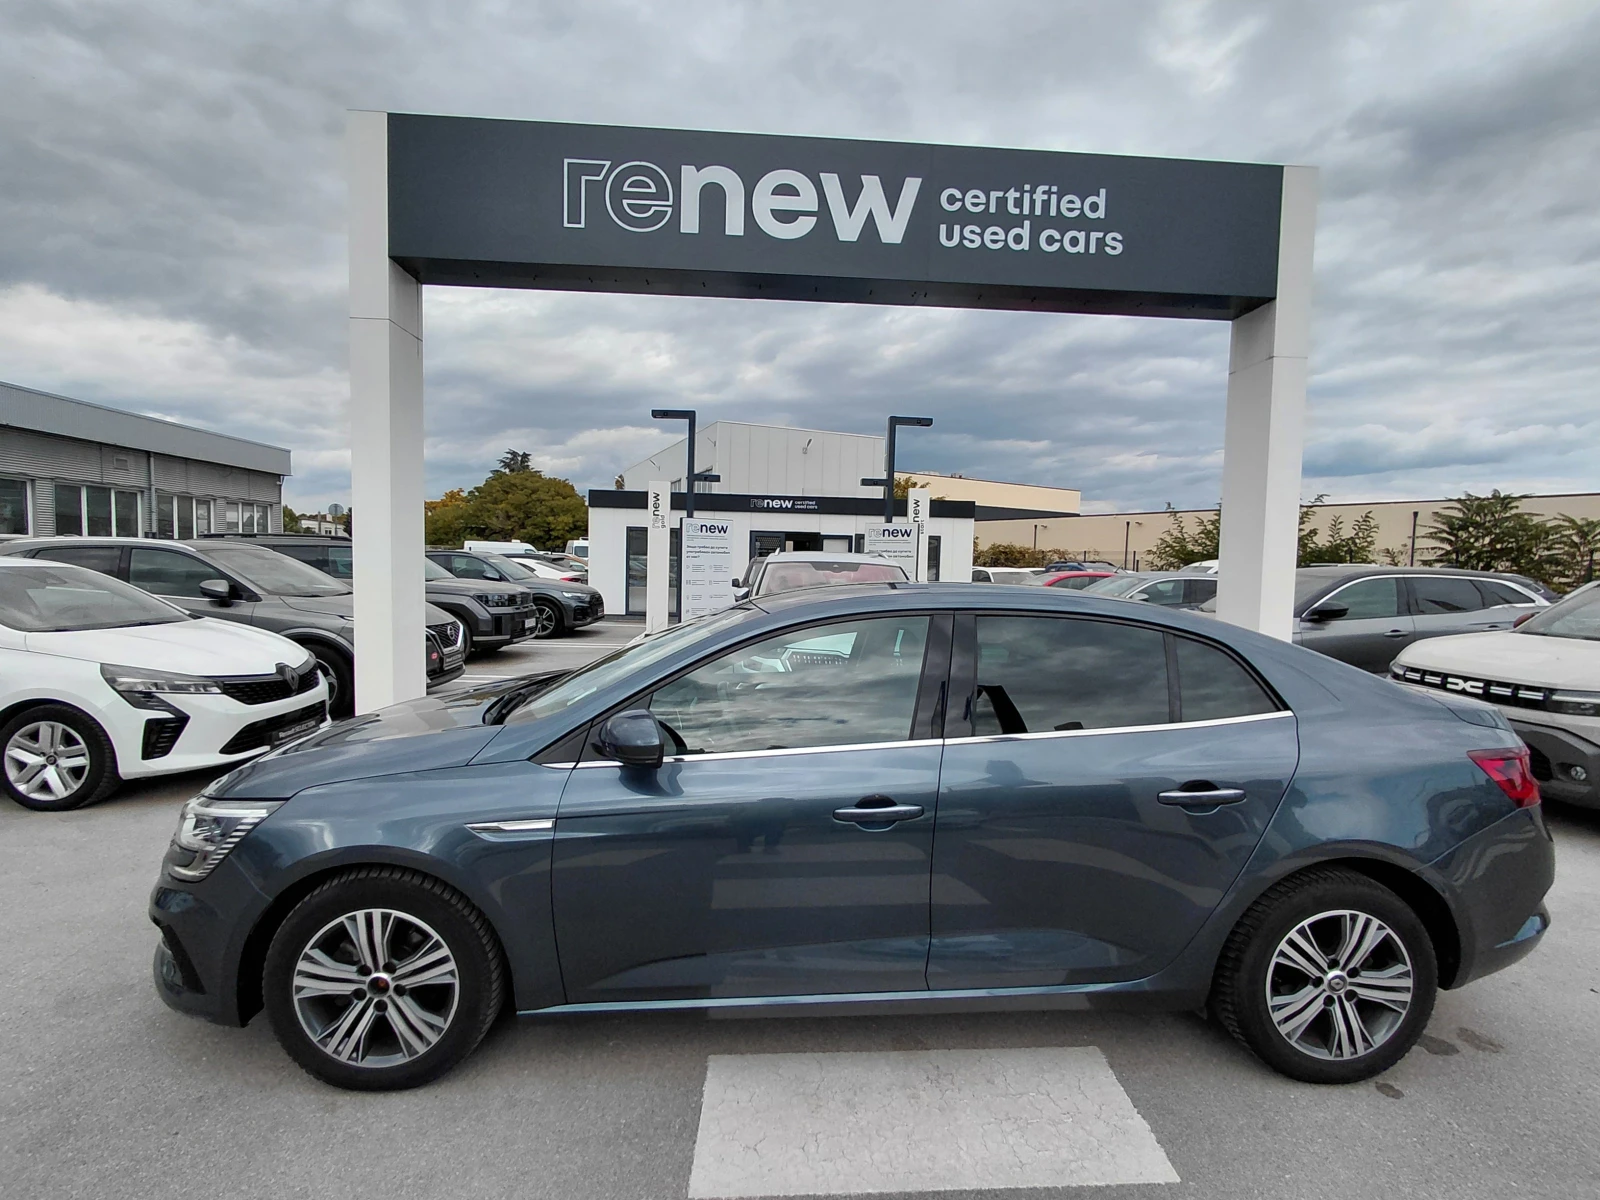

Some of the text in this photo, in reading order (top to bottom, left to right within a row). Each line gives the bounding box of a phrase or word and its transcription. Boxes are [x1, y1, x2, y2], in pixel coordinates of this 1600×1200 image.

[562, 157, 923, 244] renew
[939, 184, 1107, 220] certified
[938, 220, 1124, 256] used cars
[652, 492, 661, 529] renew
[750, 498, 793, 509] renew
[686, 523, 728, 534] renew
[869, 528, 912, 538] renew
